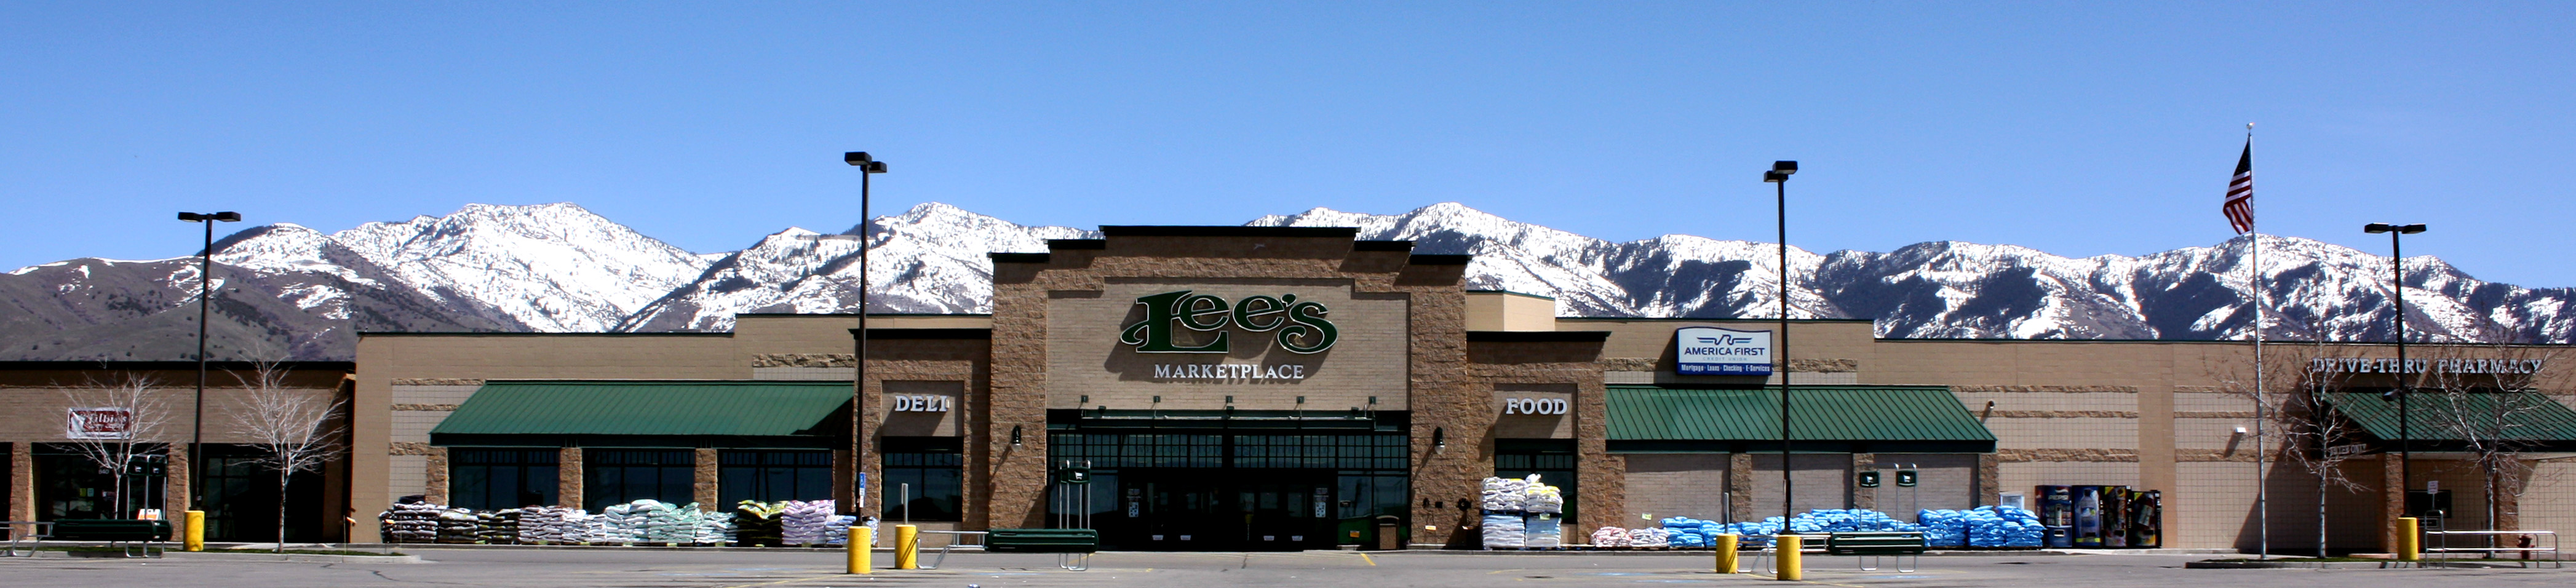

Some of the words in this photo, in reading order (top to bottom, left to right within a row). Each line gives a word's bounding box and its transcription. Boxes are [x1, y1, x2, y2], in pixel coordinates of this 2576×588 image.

[1120, 290, 1338, 354] Lee's
[1154, 364, 1304, 379] MARKETPLACE
[2313, 358, 2427, 373] DRIVE-THRU
[2438, 359, 2542, 375] PHARMACY
[895, 395, 947, 411] DELI
[1506, 398, 1568, 415] FOOD
